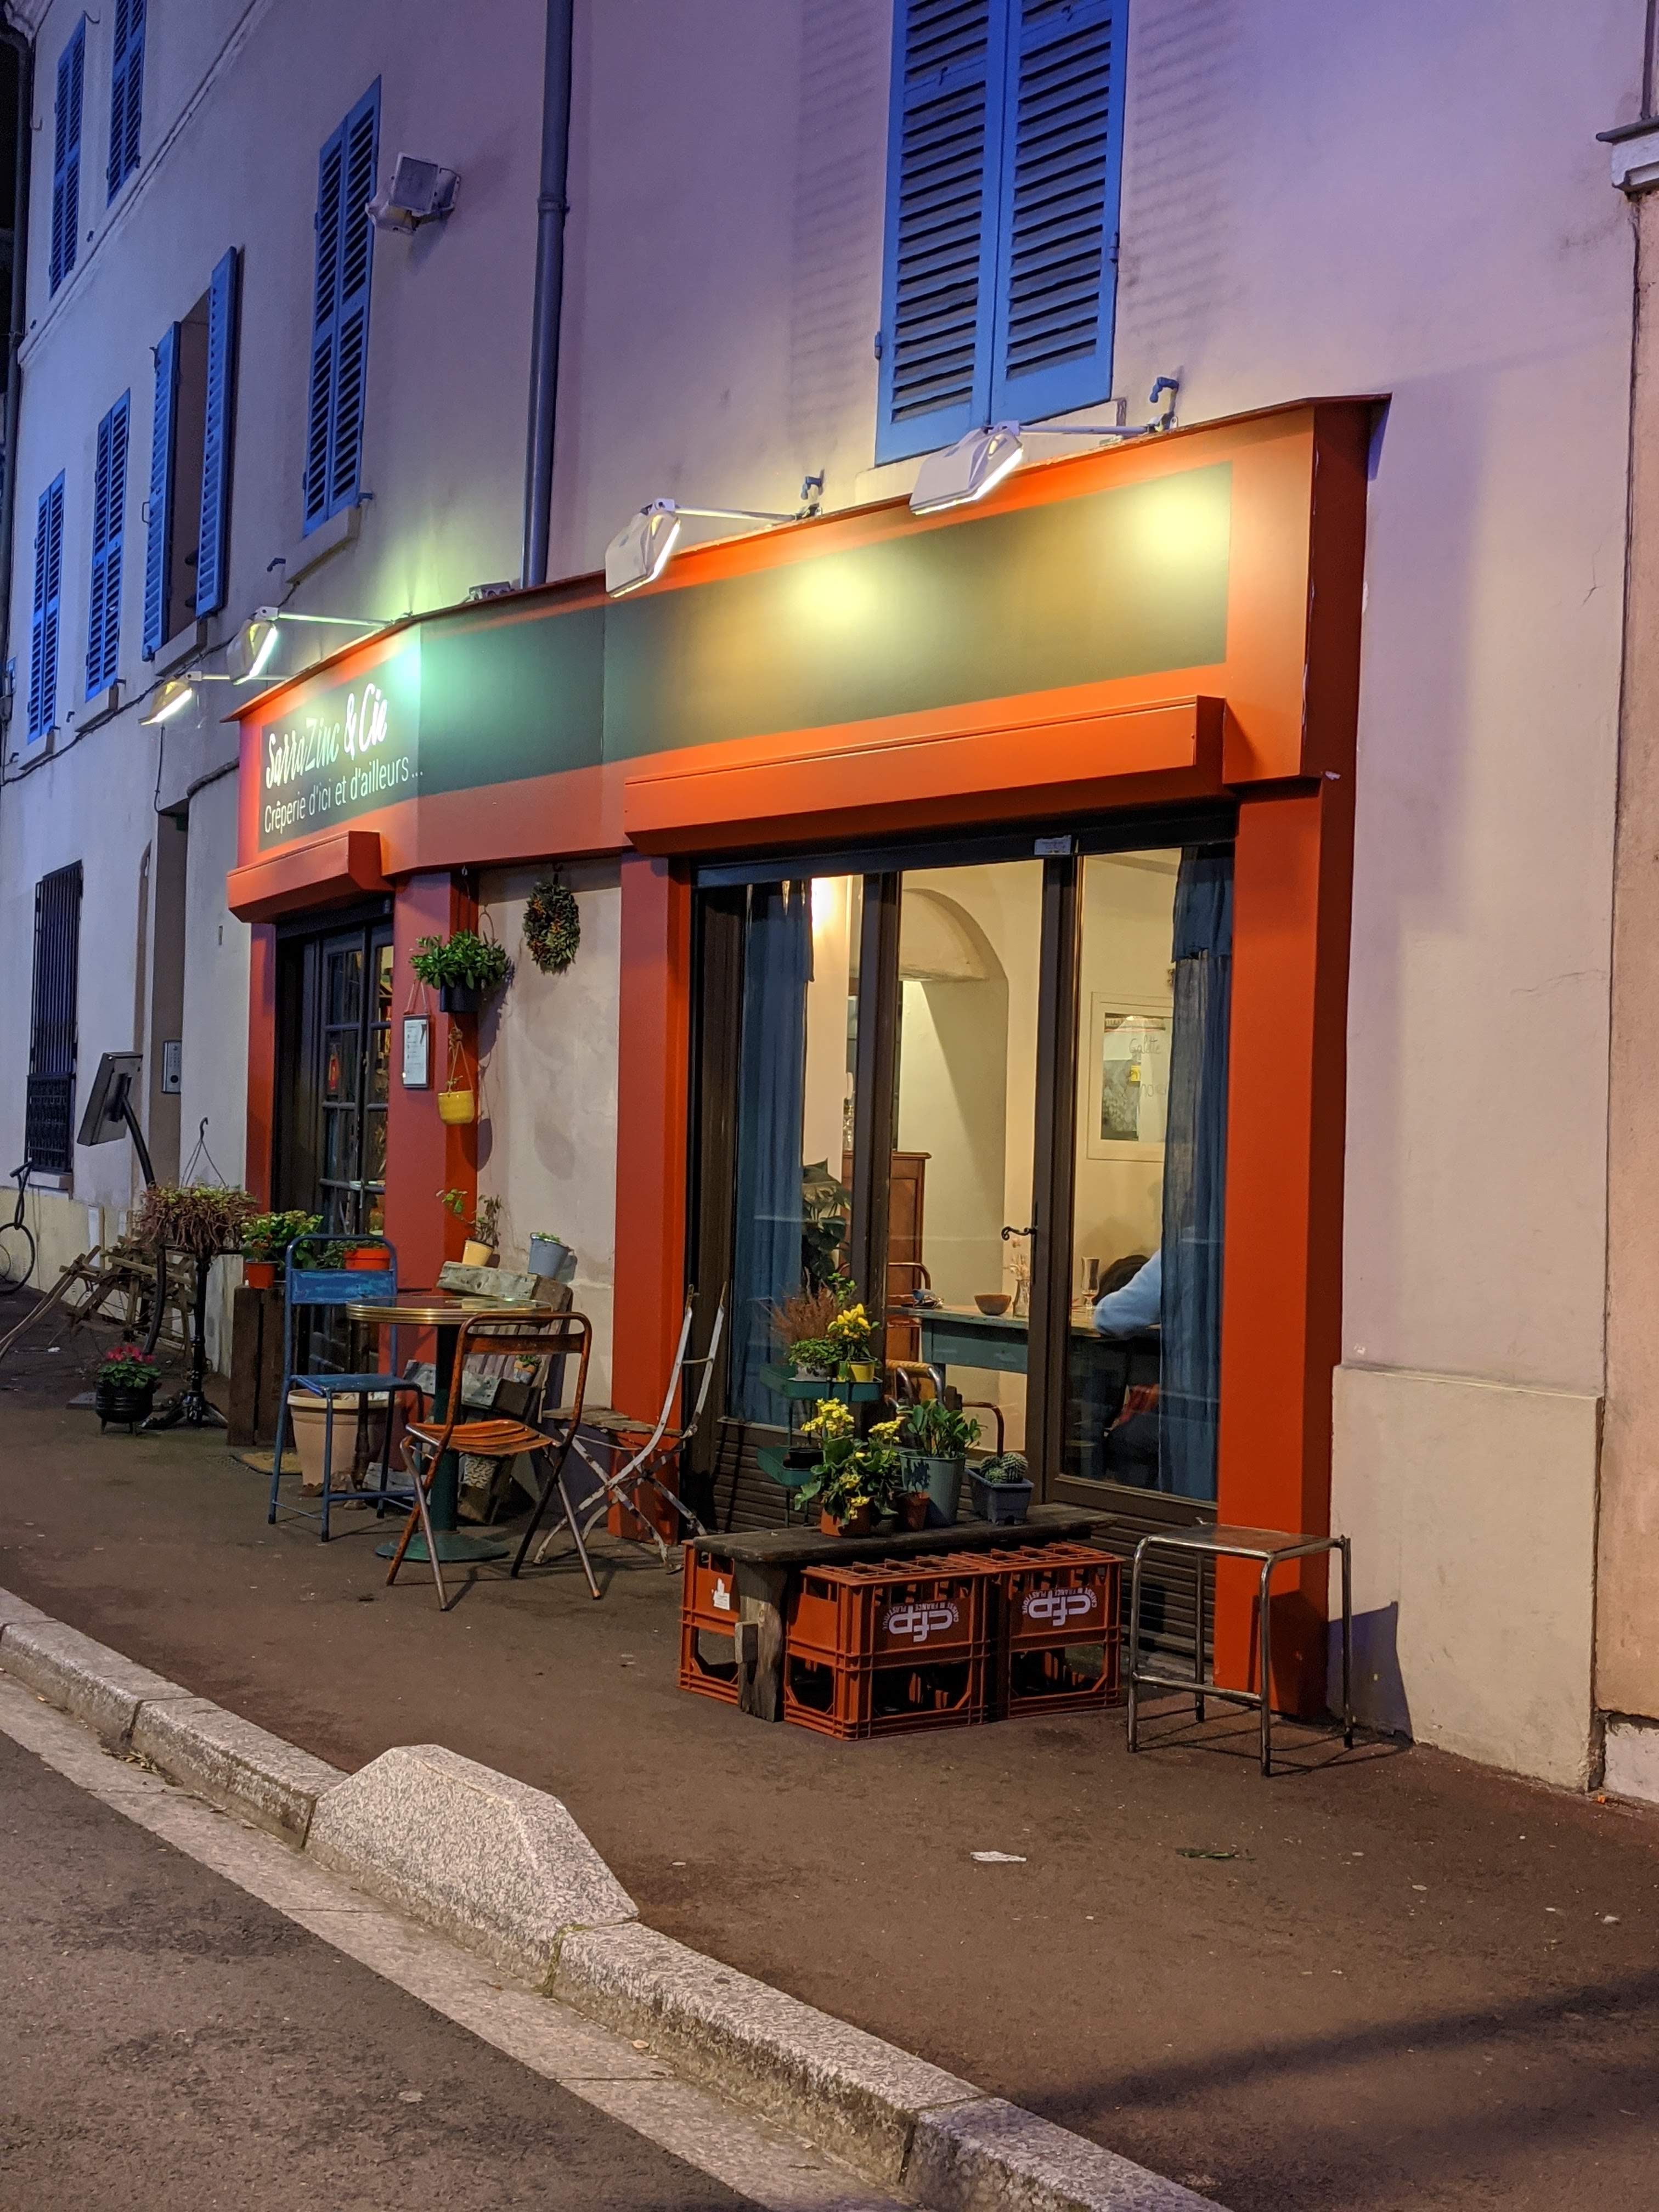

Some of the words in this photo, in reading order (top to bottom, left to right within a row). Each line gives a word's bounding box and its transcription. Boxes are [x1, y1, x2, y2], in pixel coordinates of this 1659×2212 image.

[344, 693, 357, 760] &
[359, 683, 387, 752] Cie
[264, 791, 306, 834] Crêperie
[309, 778, 331, 816] d'ici
[335, 775, 347, 805] et
